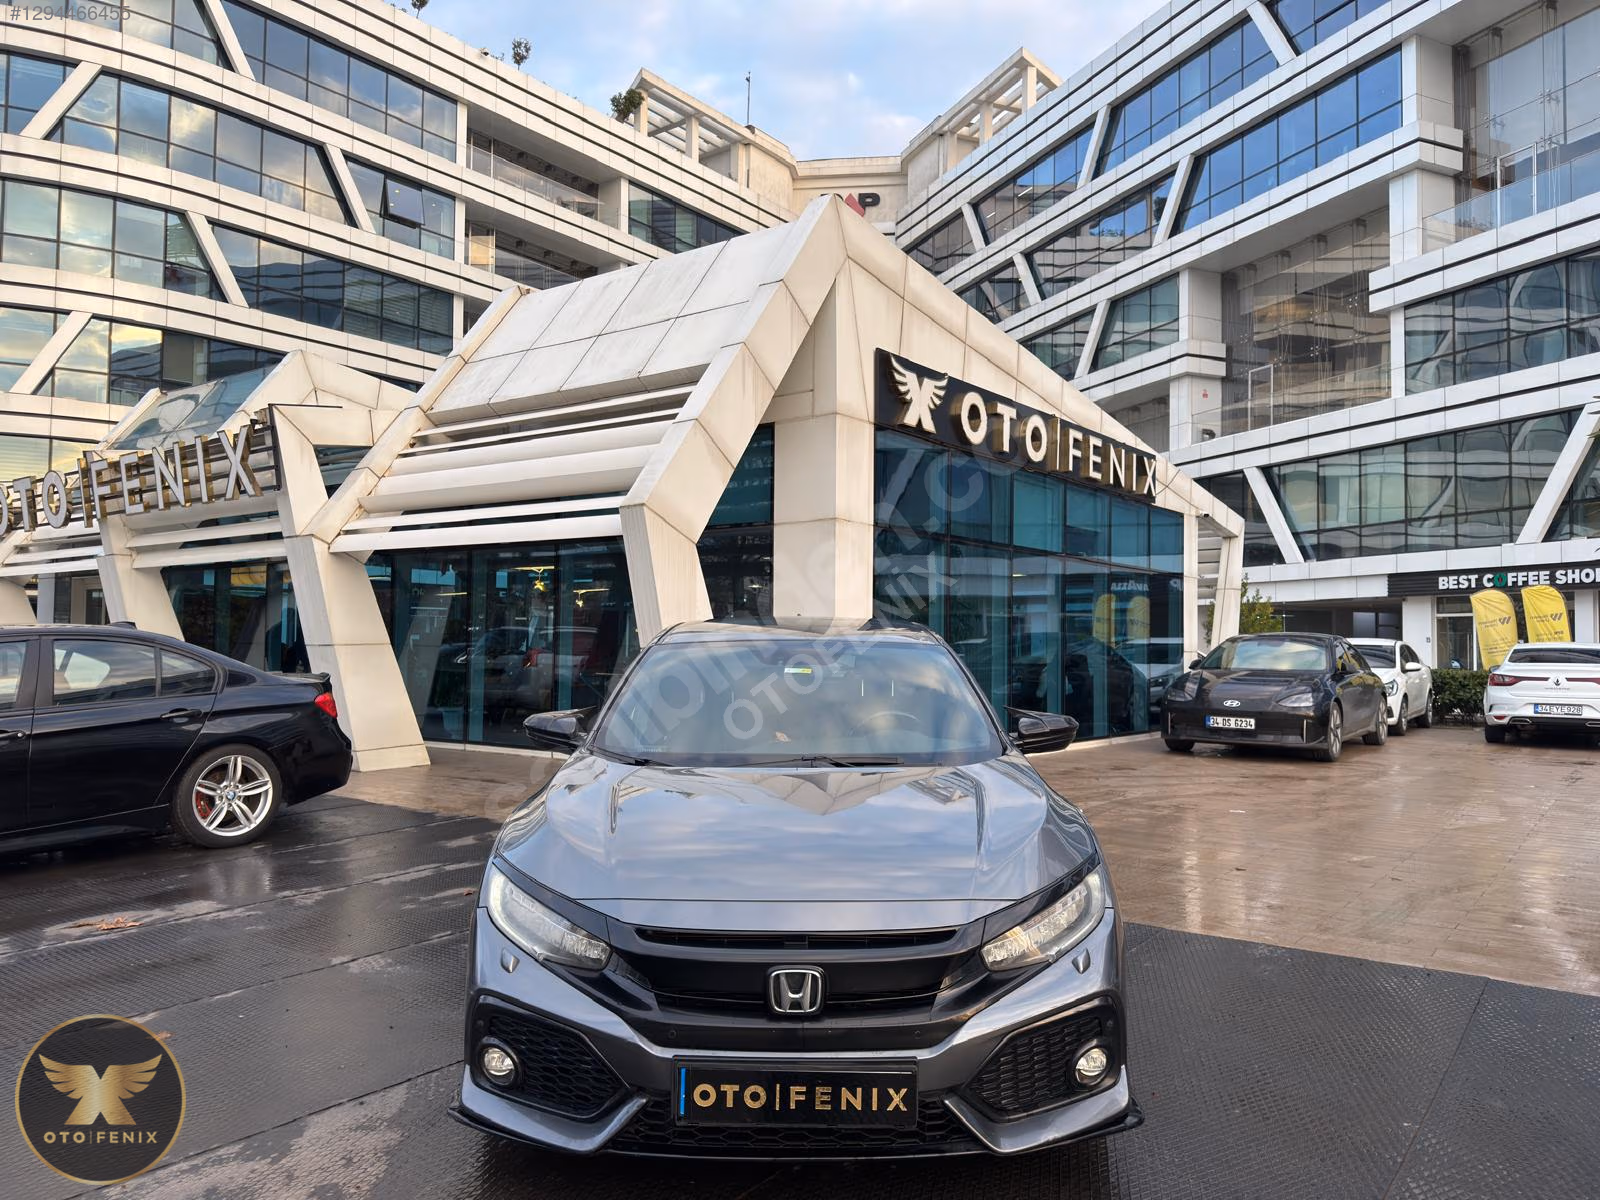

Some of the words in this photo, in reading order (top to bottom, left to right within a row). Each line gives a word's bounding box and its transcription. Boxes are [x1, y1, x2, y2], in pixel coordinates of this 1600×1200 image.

[961, 391, 1048, 463] OTO
[1068, 428, 1157, 497] FENIX
[90, 424, 262, 522] FENIX
[1438, 574, 1479, 590] BEST
[1482, 570, 1550, 588] COFFEE
[1210, 717, 1219, 726] 34
[1222, 718, 1232, 727] DS
[1234, 718, 1253, 728] 6234
[693, 1083, 767, 1109] OTO
[789, 1086, 908, 1112] FENIX
